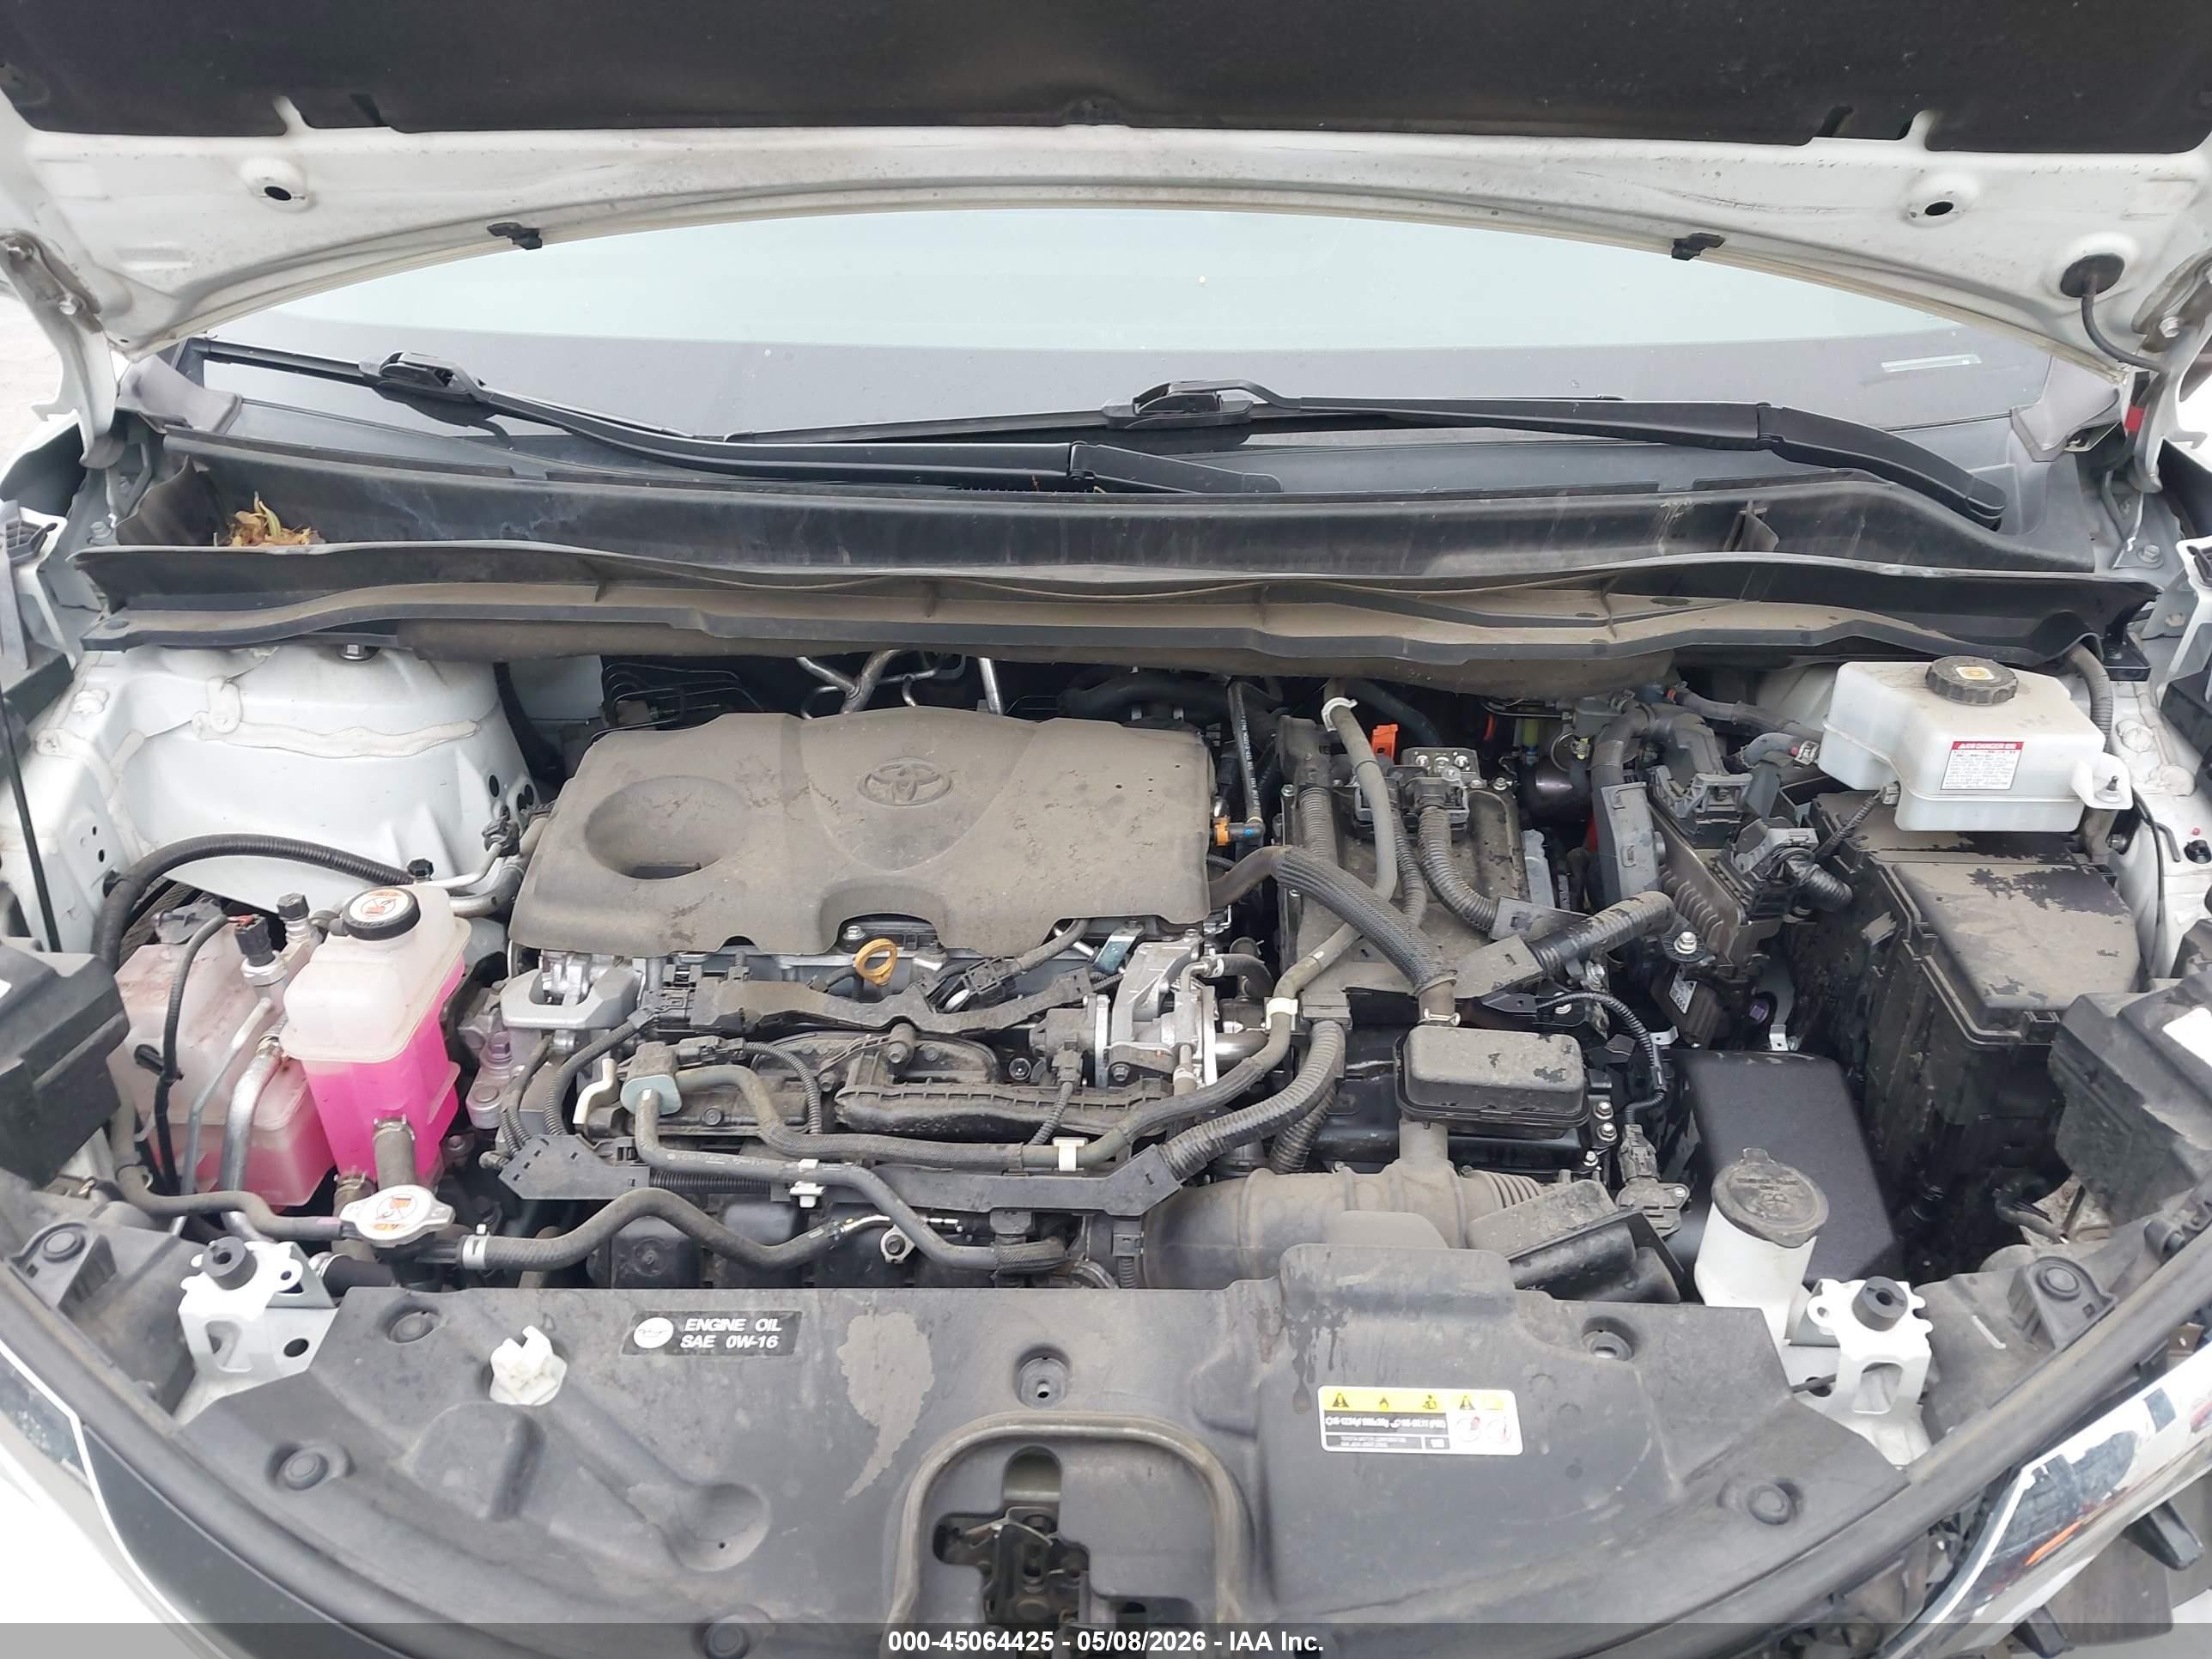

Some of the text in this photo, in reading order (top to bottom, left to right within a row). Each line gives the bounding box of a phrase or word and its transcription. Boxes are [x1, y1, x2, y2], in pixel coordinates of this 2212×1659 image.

[684, 1318, 782, 1332] ENGINE OIL
[679, 1334, 779, 1348] SAE 0W-16
